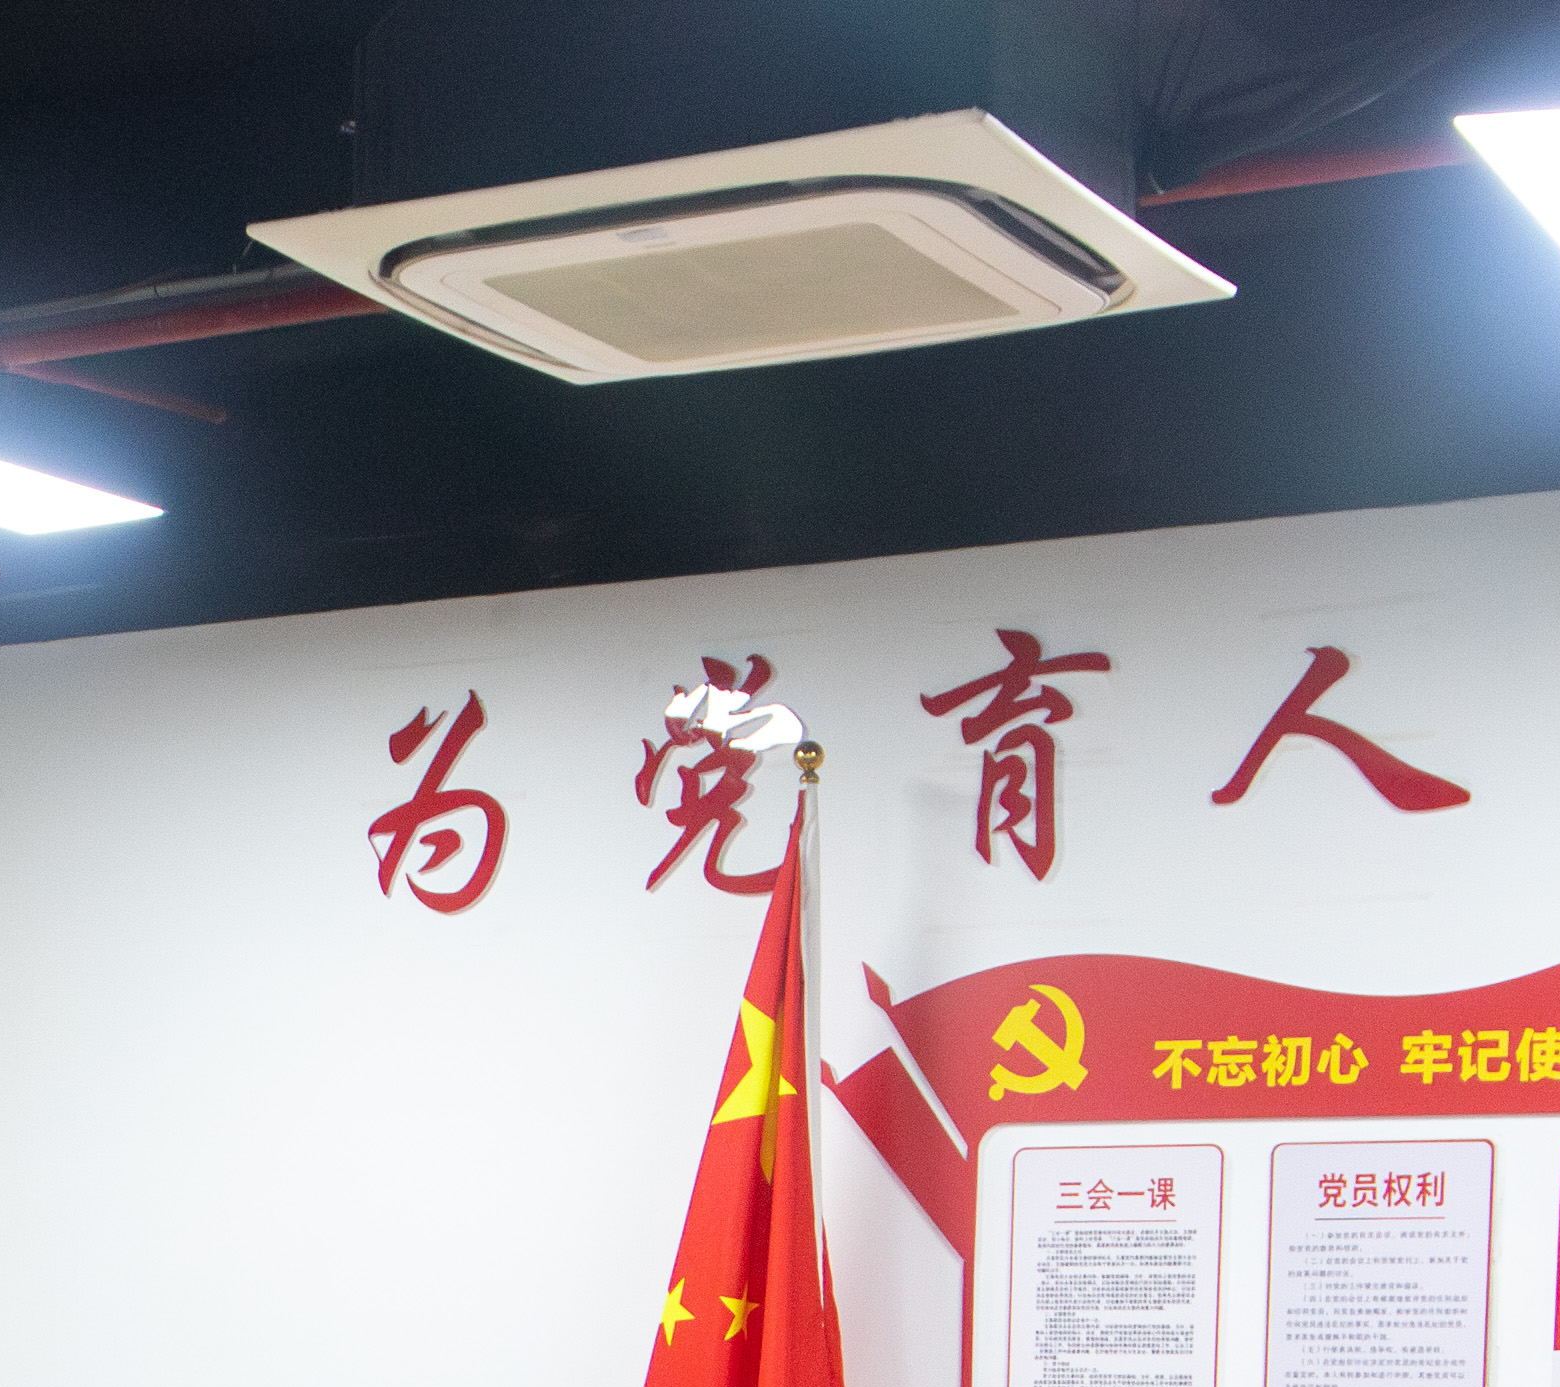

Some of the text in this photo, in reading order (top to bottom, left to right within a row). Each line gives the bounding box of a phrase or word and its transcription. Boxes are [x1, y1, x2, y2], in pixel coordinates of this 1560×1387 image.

[1152, 1033, 1369, 1090] 不忘初心
[1056, 1177, 1176, 1210] 三会一课
[1318, 1171, 1446, 1208] 党员权利
